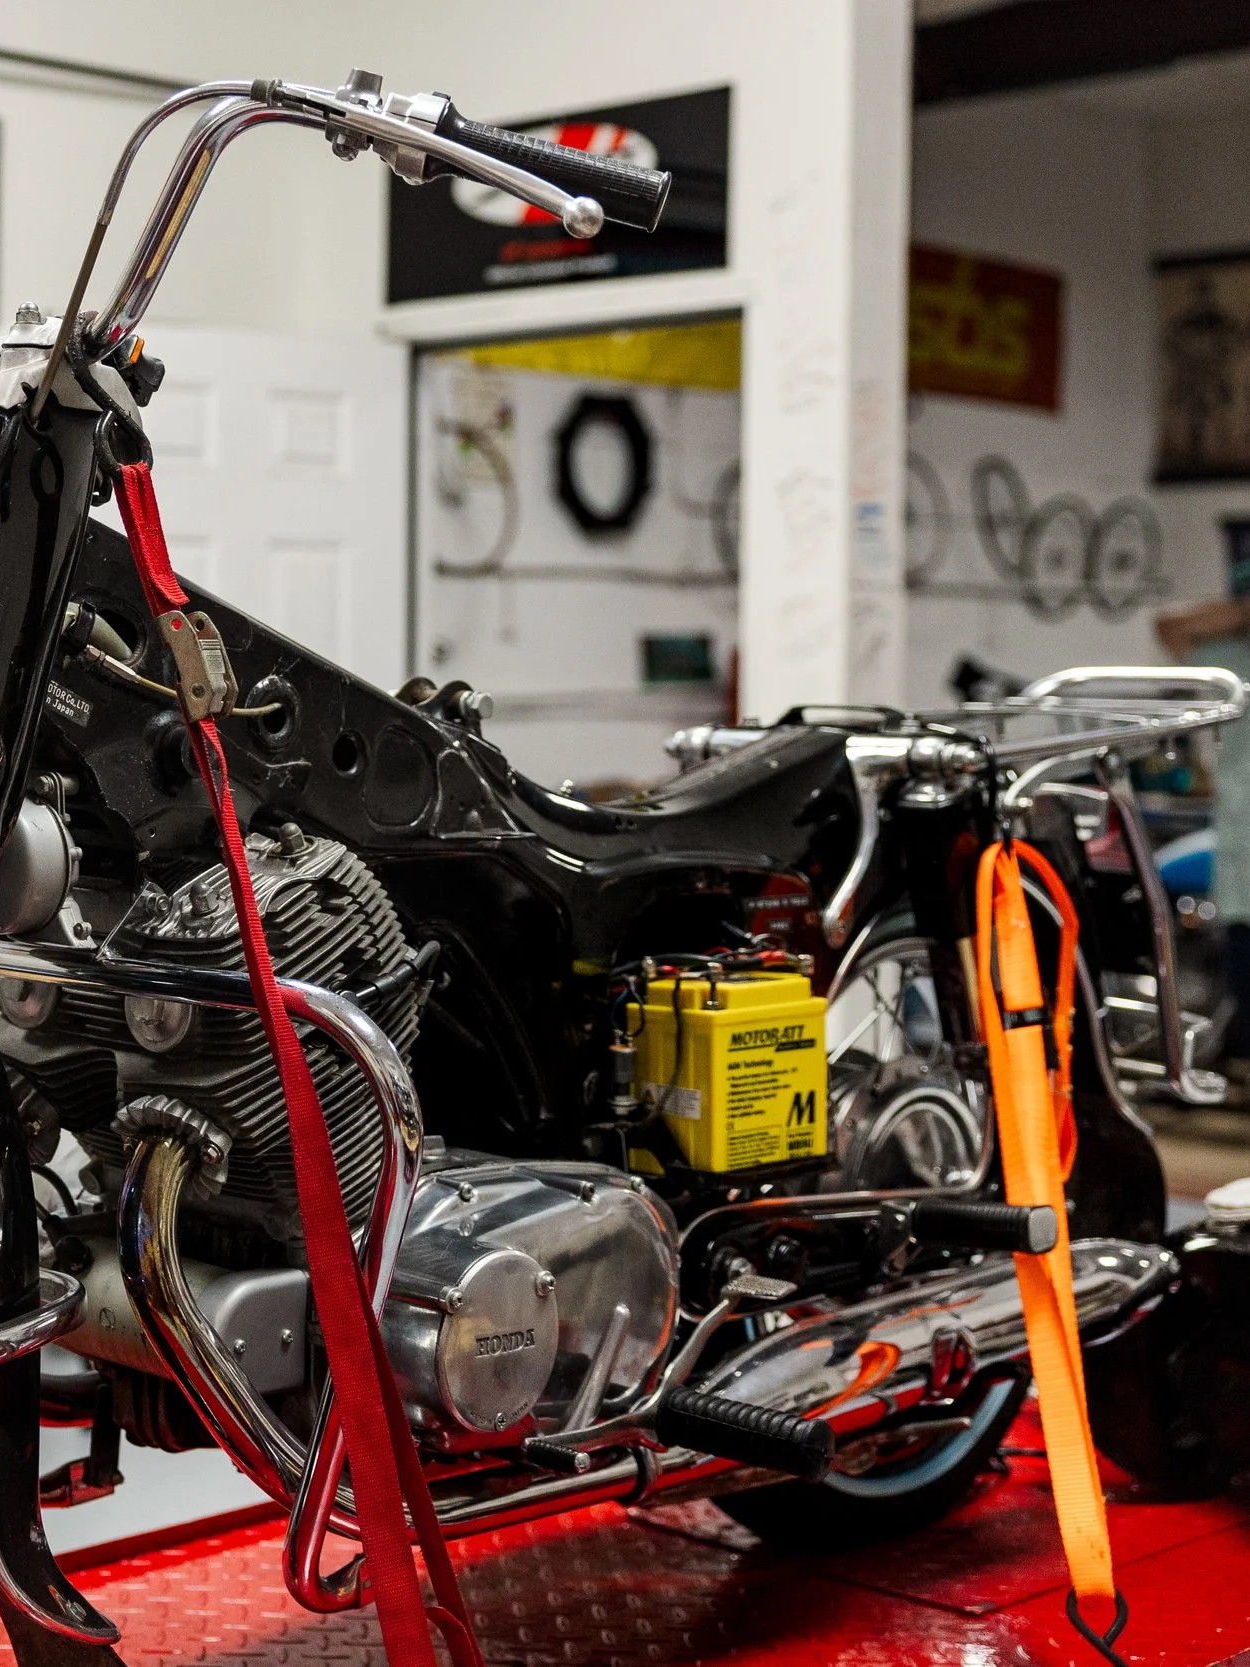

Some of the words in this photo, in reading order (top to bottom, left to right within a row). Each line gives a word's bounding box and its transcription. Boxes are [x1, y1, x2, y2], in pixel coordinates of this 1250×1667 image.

[47, 683, 67, 701] OTOR
[52, 698, 75, 717] Japan
[730, 1024, 805, 1047] MOTOBATT
[475, 1328, 535, 1358] HONDA
